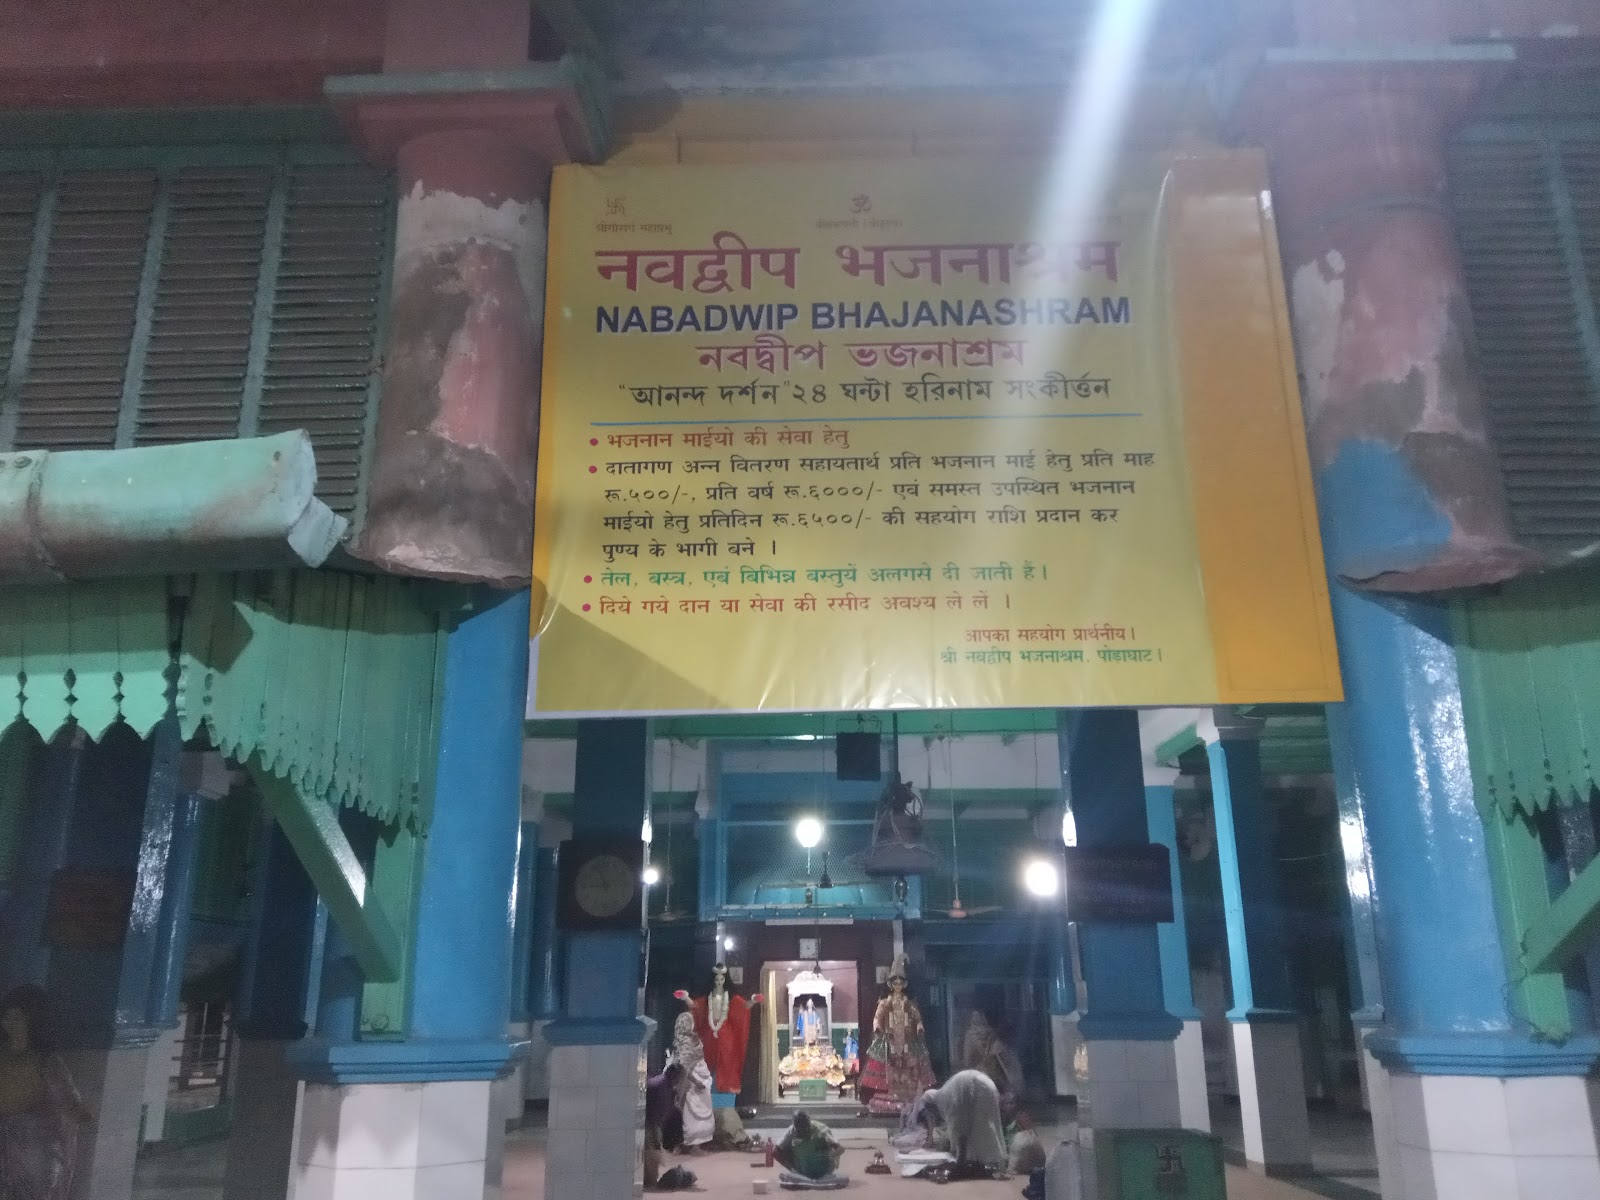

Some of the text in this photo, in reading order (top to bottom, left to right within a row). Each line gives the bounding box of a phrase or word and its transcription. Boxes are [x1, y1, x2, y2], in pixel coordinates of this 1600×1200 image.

[595, 231, 801, 293] नवद्वीप
[596, 296, 1130, 333] NABADWIP BHAJANASHRAM
[695, 334, 1028, 374] নবদ্বীপ ভজনাশ্রম
[902, 373, 992, 401] হরিনাম
[608, 434, 673, 448] भजनान
[744, 427, 767, 445] की
[777, 426, 812, 444] सेवा
[823, 425, 850, 449] हेतु
[606, 462, 672, 474] दातागण
[683, 460, 720, 473] अन्न
[730, 455, 790, 472] वितरण
[890, 452, 921, 469] प्रति
[931, 456, 994, 469] भजनान
[1005, 449, 1035, 468] माई
[1046, 449, 1072, 472] हेतु
[1081, 449, 1113, 466] प्रति
[1123, 453, 1154, 466] माह
[706, 482, 737, 500] प्रति
[748, 481, 774, 499] वर्ष
[929, 483, 981, 496] समस्त
[992, 477, 1059, 496] उपस्थित
[1070, 481, 1135, 494] भजनान
[664, 511, 689, 533] हेतु
[699, 509, 762, 528] प्रतिदिन
[882, 507, 905, 524] की
[915, 506, 976, 524] सहयोग
[986, 505, 1026, 523] राशि
[1036, 510, 1080, 522] प्रदान
[1090, 509, 1118, 522] कर
[602, 545, 639, 563] पुण्य
[649, 539, 666, 556] के
[676, 538, 718, 556] भागी
[942, 562, 960, 580] दी
[971, 562, 1012, 580] जाती
[600, 596, 632, 614] दिये
[641, 596, 669, 614] गये
[679, 600, 710, 613] दान
[720, 600, 740, 612] या
[749, 594, 784, 612] सेवा
[794, 593, 816, 611] की
[827, 592, 871, 611] रसीद
[882, 596, 937, 611] अवश्य
[946, 591, 962, 608] ले
[967, 630, 1010, 641] आपका
[1017, 624, 1065, 641] सहयोग
[941, 647, 956, 663] श्री
